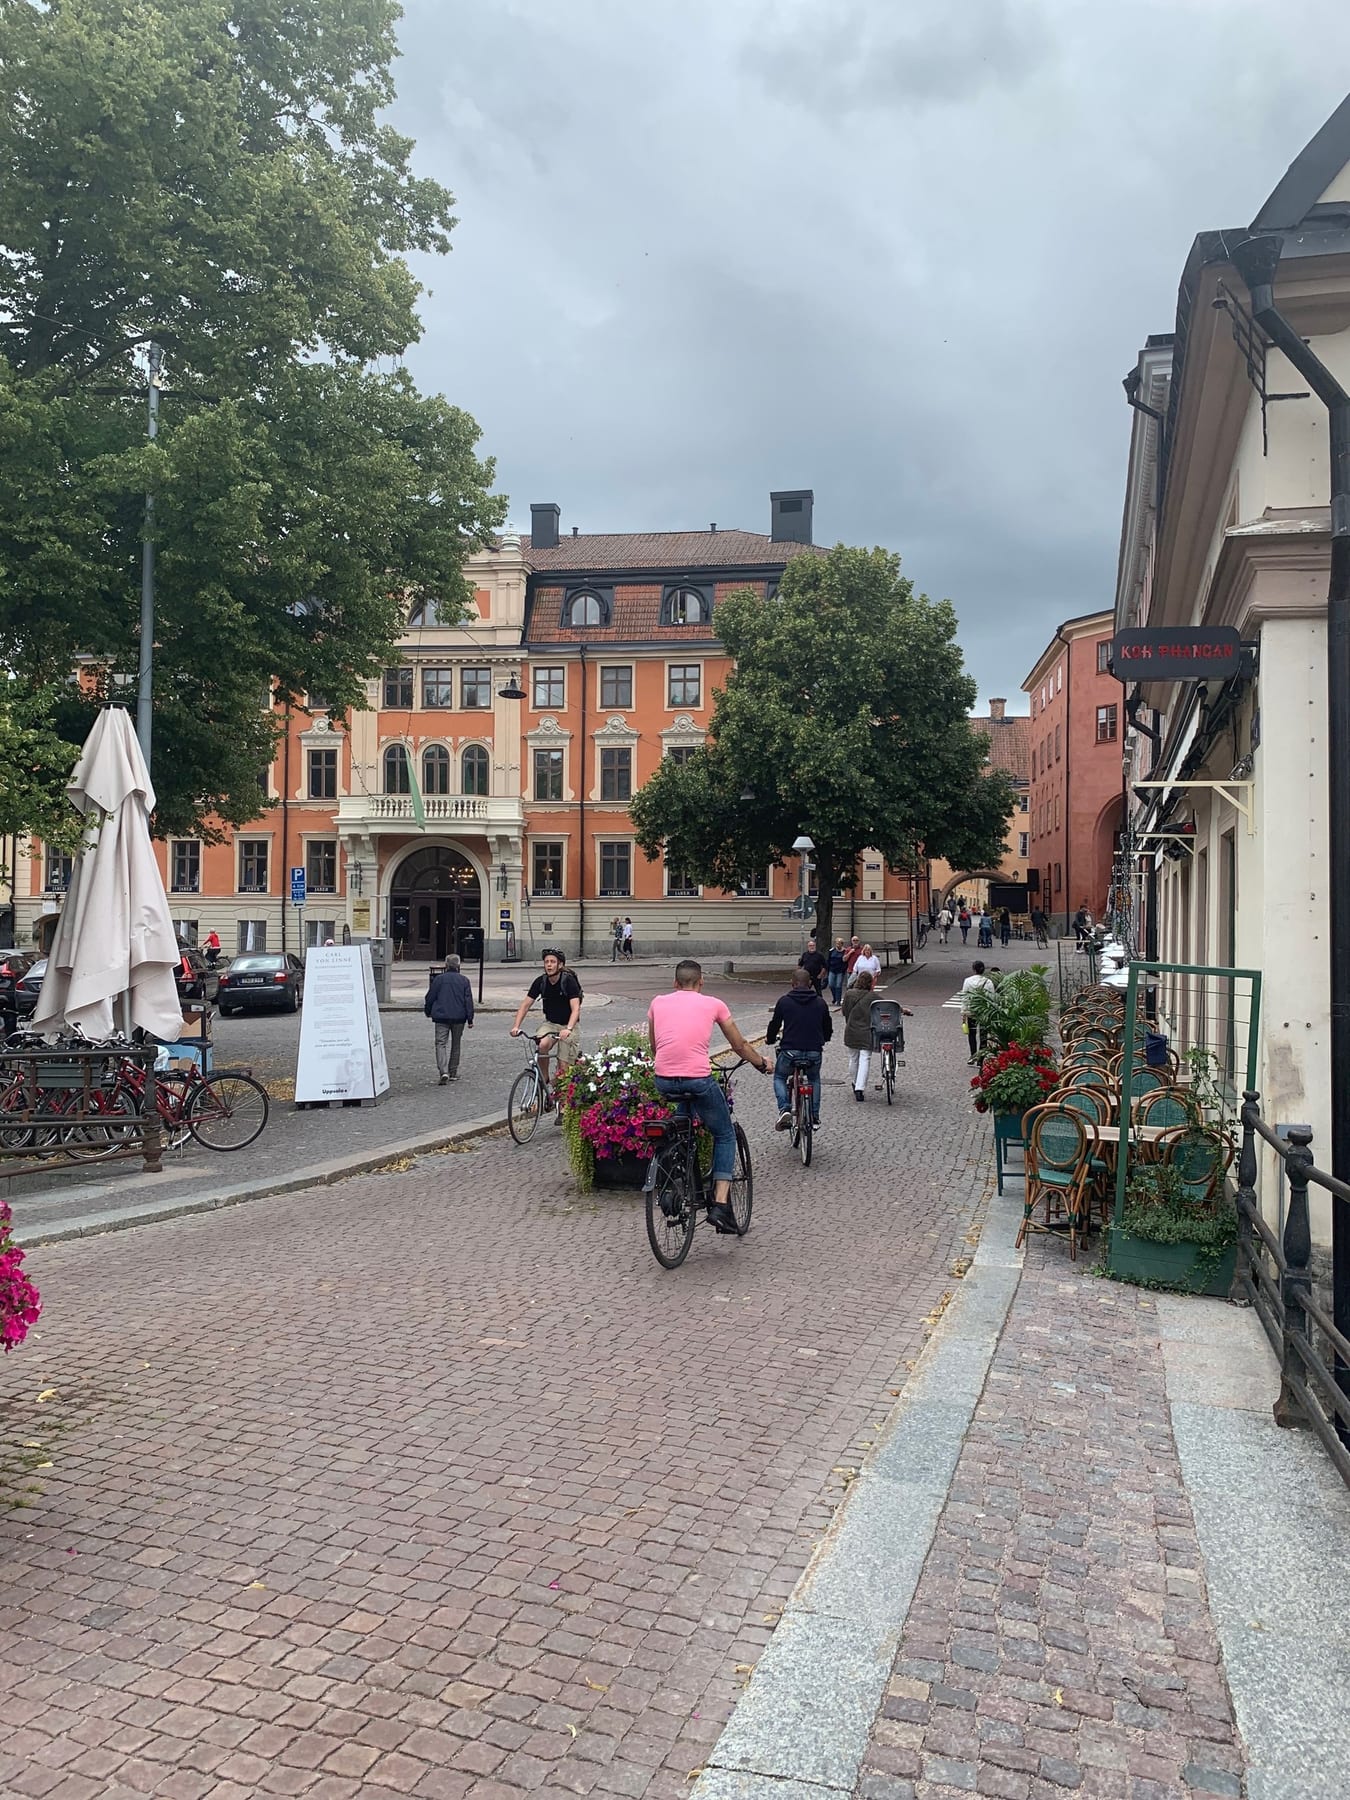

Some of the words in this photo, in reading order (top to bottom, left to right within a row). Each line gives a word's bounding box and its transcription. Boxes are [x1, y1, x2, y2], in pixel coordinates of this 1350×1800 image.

[1121, 645, 1153, 659] KOH
[1158, 644, 1233, 659] PHANGAN
[294, 868, 304, 881] P
[321, 1087, 344, 1095] Uppsala
